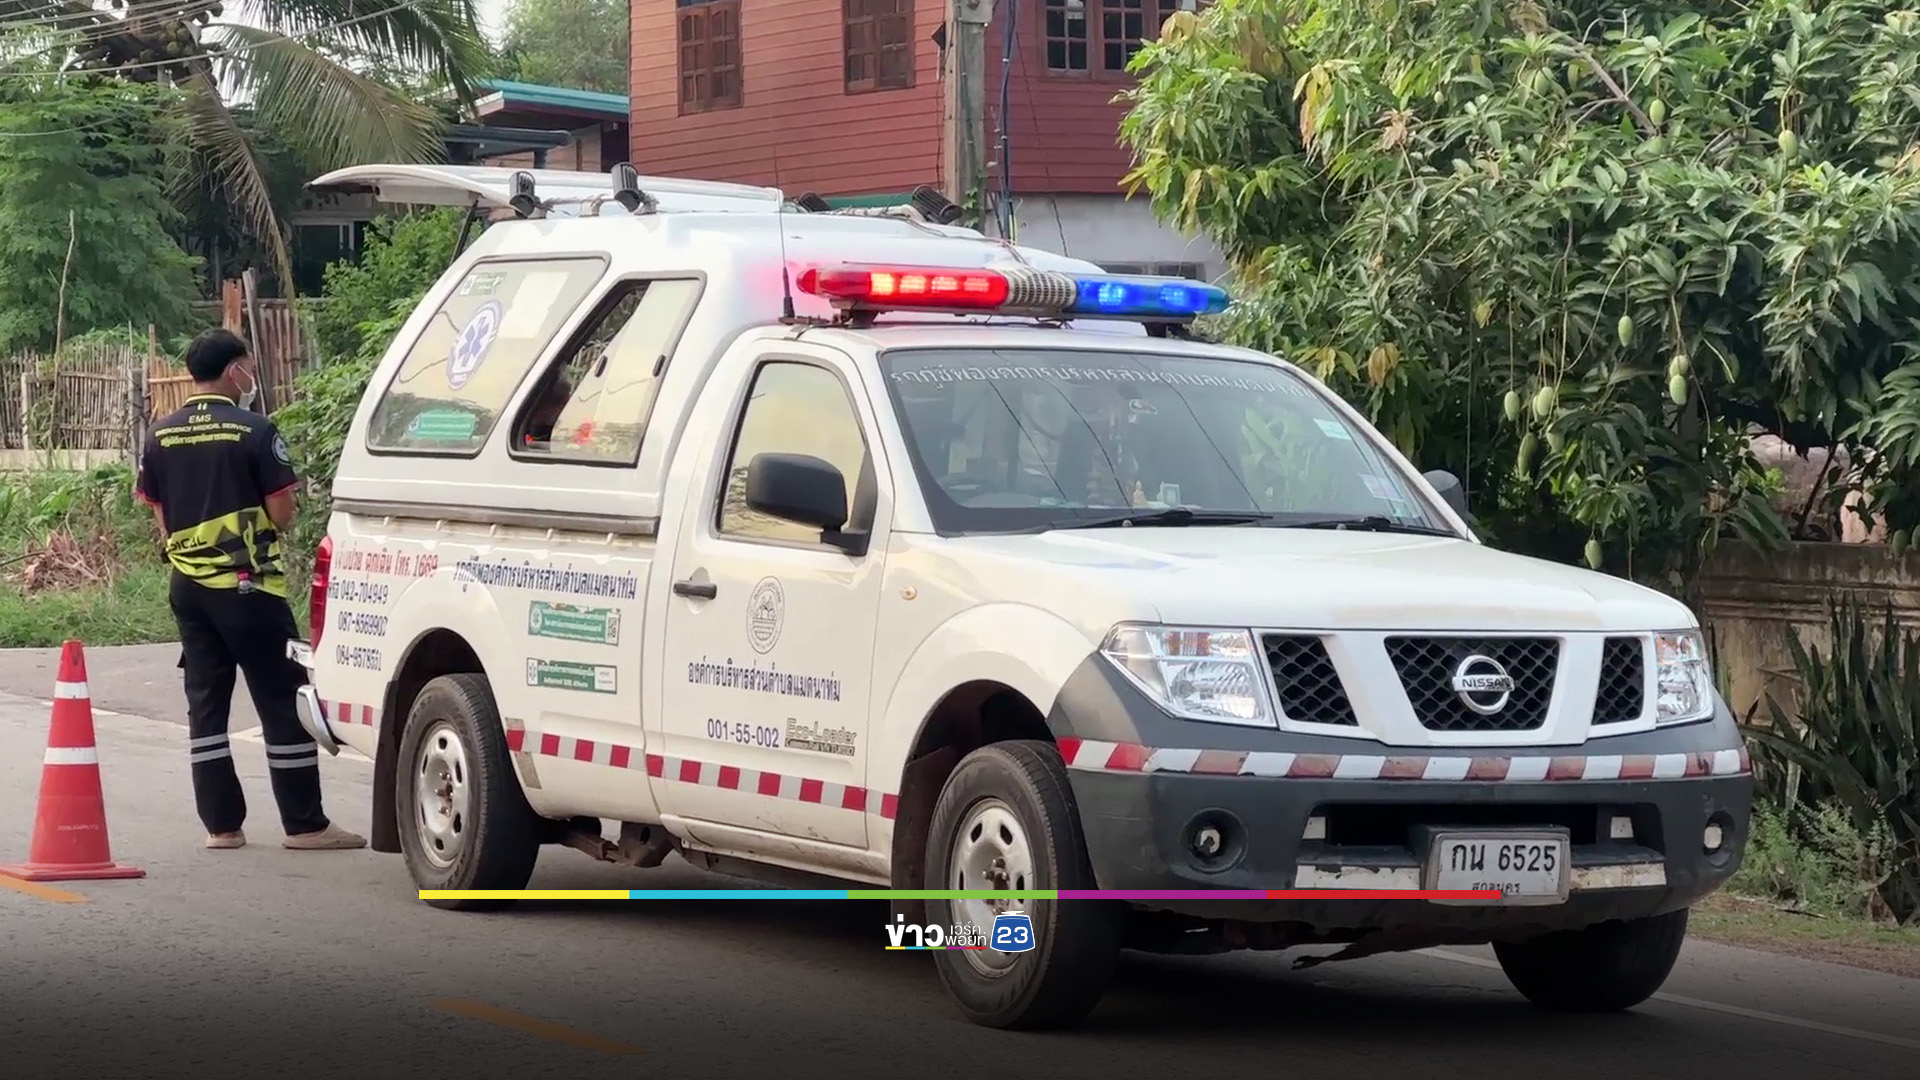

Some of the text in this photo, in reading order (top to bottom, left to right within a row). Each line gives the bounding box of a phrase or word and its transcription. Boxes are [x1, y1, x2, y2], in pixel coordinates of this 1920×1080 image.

[188, 413, 212, 424] EMS
[412, 554, 439, 578] 1669
[1461, 677, 1511, 690] NISSAN
[707, 718, 780, 748] 001-55-002
[785, 717, 858, 746] Eco-Loader
[1451, 844, 1556, 872] กน 6525
